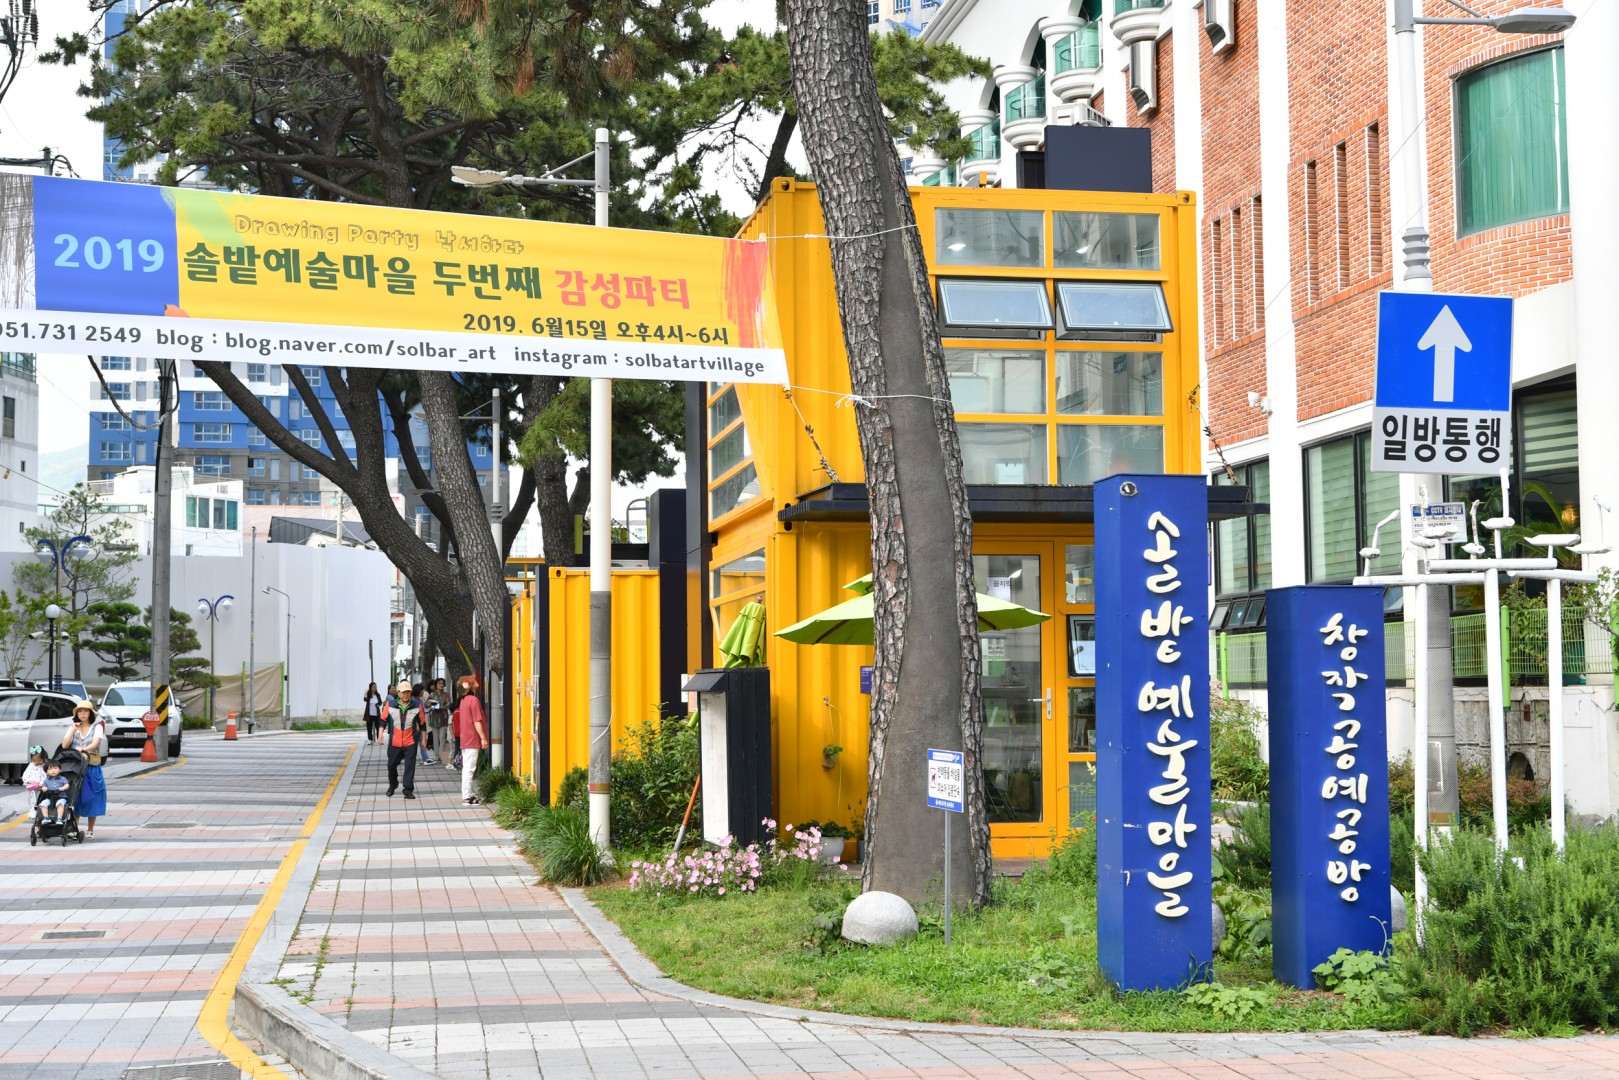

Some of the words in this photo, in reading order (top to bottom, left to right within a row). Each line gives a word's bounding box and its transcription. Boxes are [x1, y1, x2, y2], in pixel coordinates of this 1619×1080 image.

[235, 214, 338, 244] Drawing
[347, 224, 419, 250] Party
[435, 230, 525, 255] 낙서하다
[53, 233, 165, 273] 2019
[183, 242, 417, 296] 솔밭예술마을
[433, 261, 542, 300] 두번째
[555, 269, 691, 309] 감성파티
[0, 321, 76, 340] 51.731
[85, 325, 142, 343] 2549
[156, 329, 204, 352] blog
[225, 332, 497, 363] blog.naver.com/solbar_art
[514, 346, 608, 370] instagram
[625, 353, 765, 377] solbatartvillage
[463, 313, 523, 334] 2019.
[531, 317, 608, 341] 6월15일
[616, 321, 729, 345] 오후4시~6시
[1382, 414, 1502, 464] 일방통행
[1138, 511, 1198, 918] 솔밭예술마을
[1319, 612, 1372, 902] 창작공예공방
